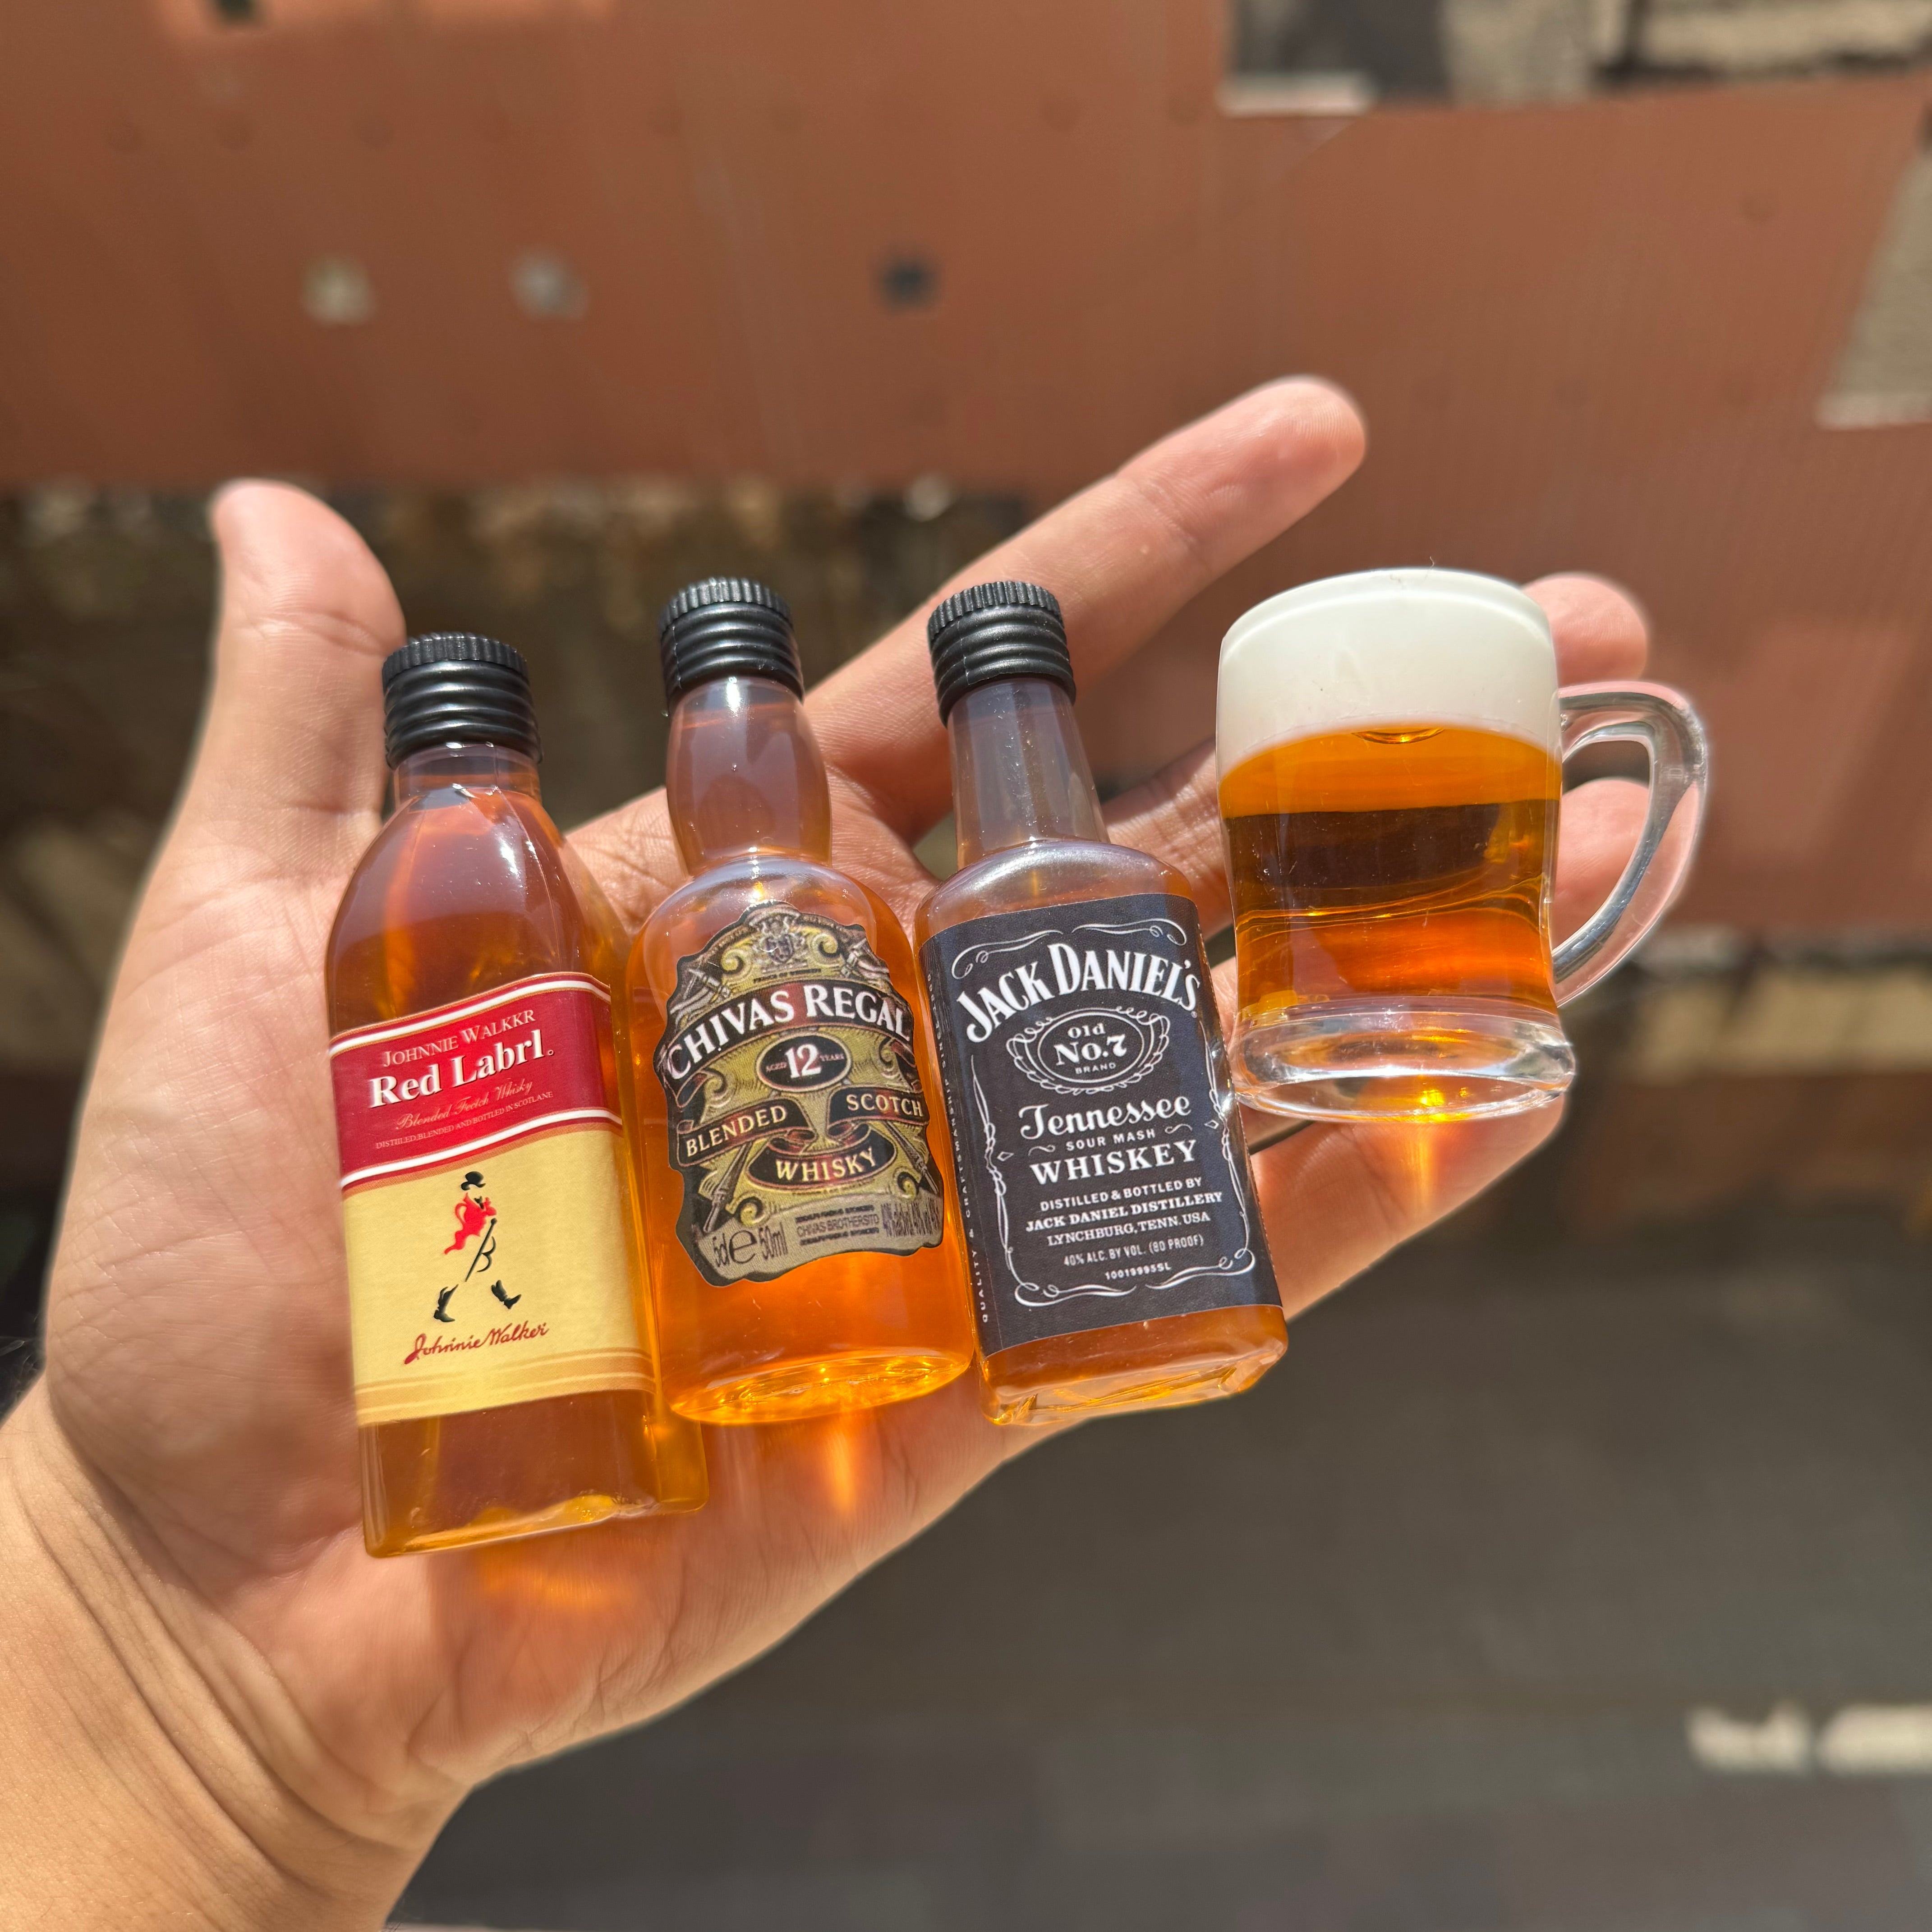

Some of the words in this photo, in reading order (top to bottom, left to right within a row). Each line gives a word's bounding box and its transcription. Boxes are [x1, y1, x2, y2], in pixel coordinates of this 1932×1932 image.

[956, 961, 1055, 1043] JACK
[1047, 943, 1200, 1011] DANIEL'S
[667, 991, 795, 1080] CHIVAS
[804, 984, 910, 1041] REGAL
[1067, 1023, 1106, 1039] Old
[383, 1035, 459, 1067] JOHNNIE
[785, 1044, 822, 1078] 12
[1075, 1062, 1117, 1074] BRAND
[368, 1063, 442, 1109] Red
[456, 1119, 472, 1130] AND
[473, 1108, 505, 1125] BOTTLED
[686, 1105, 787, 1157] BLENDED
[846, 1094, 924, 1117] SCOTCH
[1018, 1096, 1191, 1140] Tennessee
[1066, 1136, 1106, 1151] SOUR
[1113, 1128, 1156, 1144] MASH
[776, 1147, 877, 1182] WHISKY
[1030, 1140, 1196, 1185] WHISKEY
[1040, 1191, 1109, 1211] DISTILLED
[1111, 1190, 1122, 1200] &
[1123, 1181, 1183, 1198] BOTTLED
[1185, 1177, 1202, 1188] BY
[1026, 1216, 1066, 1232] JACK
[1069, 1205, 1129, 1225] DANIEL
[1131, 1191, 1223, 1215] DISTILLERY
[1183, 1211, 1211, 1224] USA
[1063, 1254, 1085, 1266] 40%
[1086, 1250, 1108, 1262] ALC.
[1109, 1247, 1121, 1259] BY
[1123, 1244, 1146, 1258] VOL.
[1168, 1234, 1204, 1251] PROOF)
[972, 1250, 988, 1323] QUALITY
